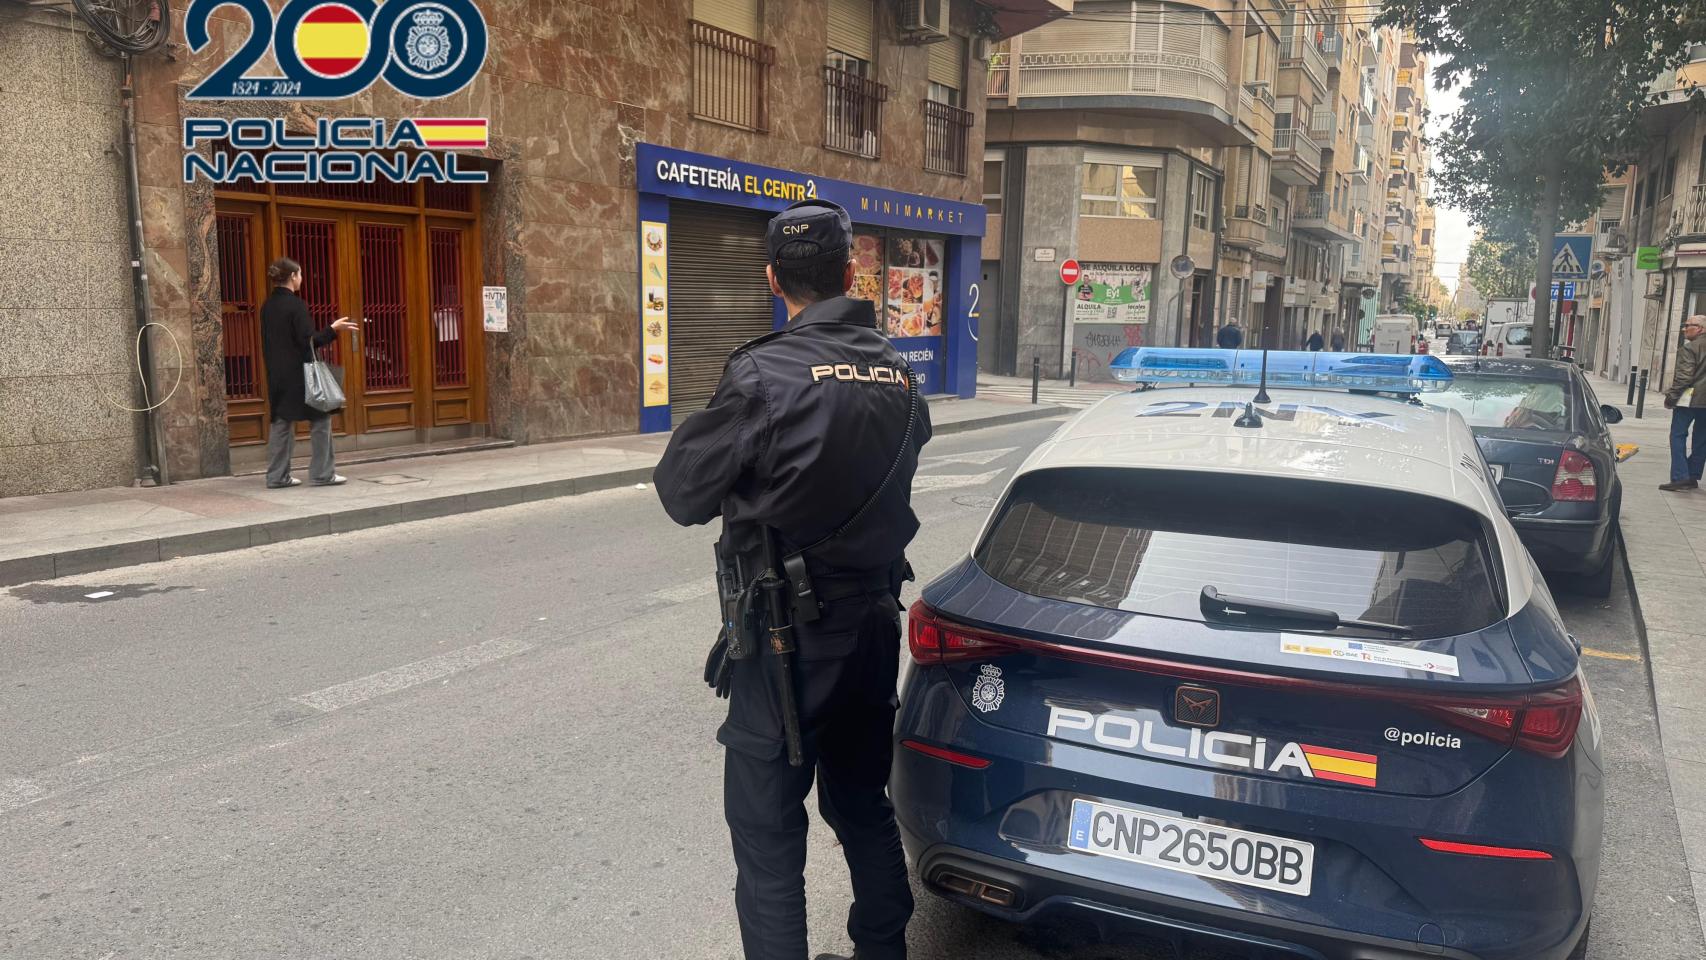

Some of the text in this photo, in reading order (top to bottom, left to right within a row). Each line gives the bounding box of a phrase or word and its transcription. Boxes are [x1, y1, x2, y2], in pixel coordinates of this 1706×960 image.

[656, 160, 741, 192] CAFETERÍA
[744, 175, 762, 195] EL
[861, 197, 963, 224] MINIMARKET
[782, 224, 809, 235] CNP
[1093, 264, 1123, 272] ALQUILA
[1125, 264, 1149, 272] LOCAL
[1384, 727, 1461, 749] @policia
[1092, 811, 1304, 885] CNP2650BB
